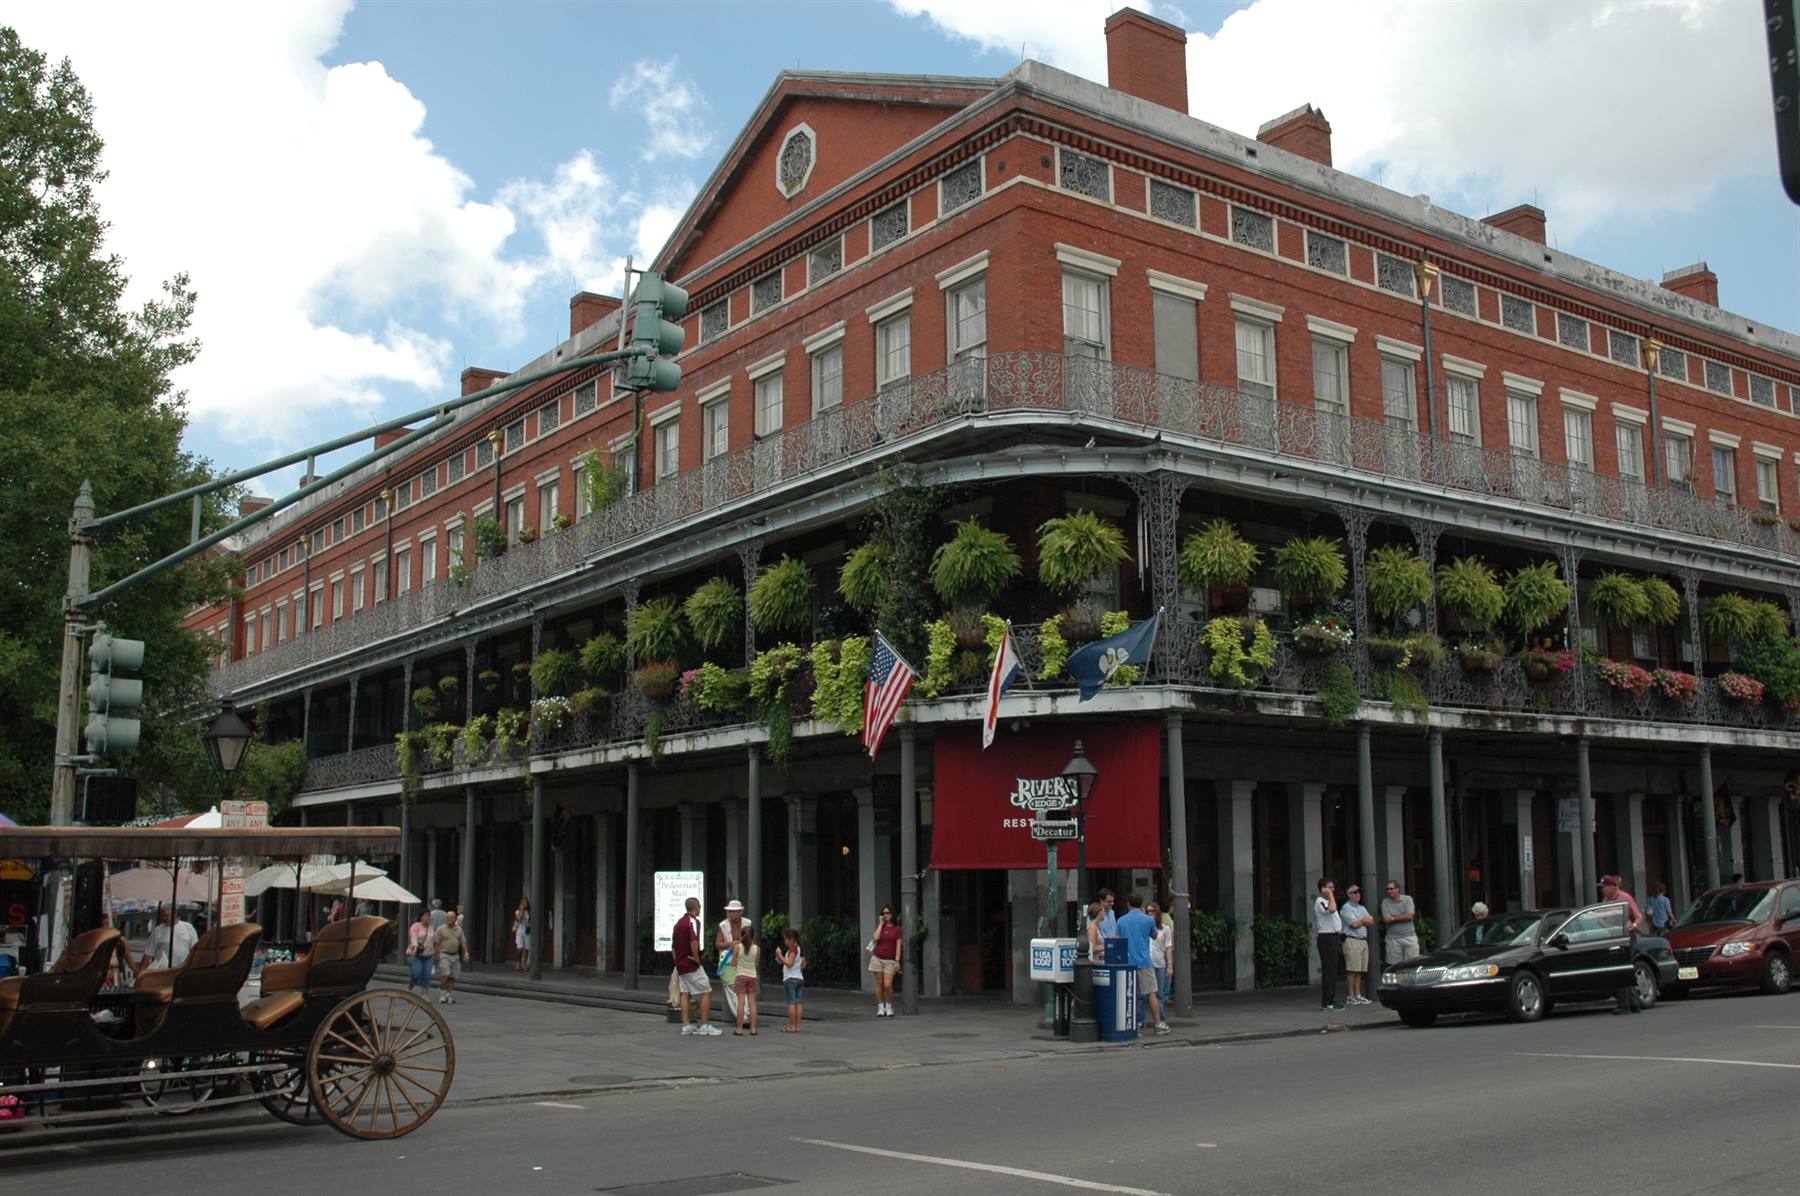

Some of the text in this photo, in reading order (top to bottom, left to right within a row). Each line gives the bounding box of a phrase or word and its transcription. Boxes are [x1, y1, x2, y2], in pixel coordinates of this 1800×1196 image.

[1037, 827, 1074, 836] Decatur
[661, 881, 698, 889] Pedestrian
[1039, 950, 1051, 958] USA
[1034, 958, 1052, 967] TODAY
